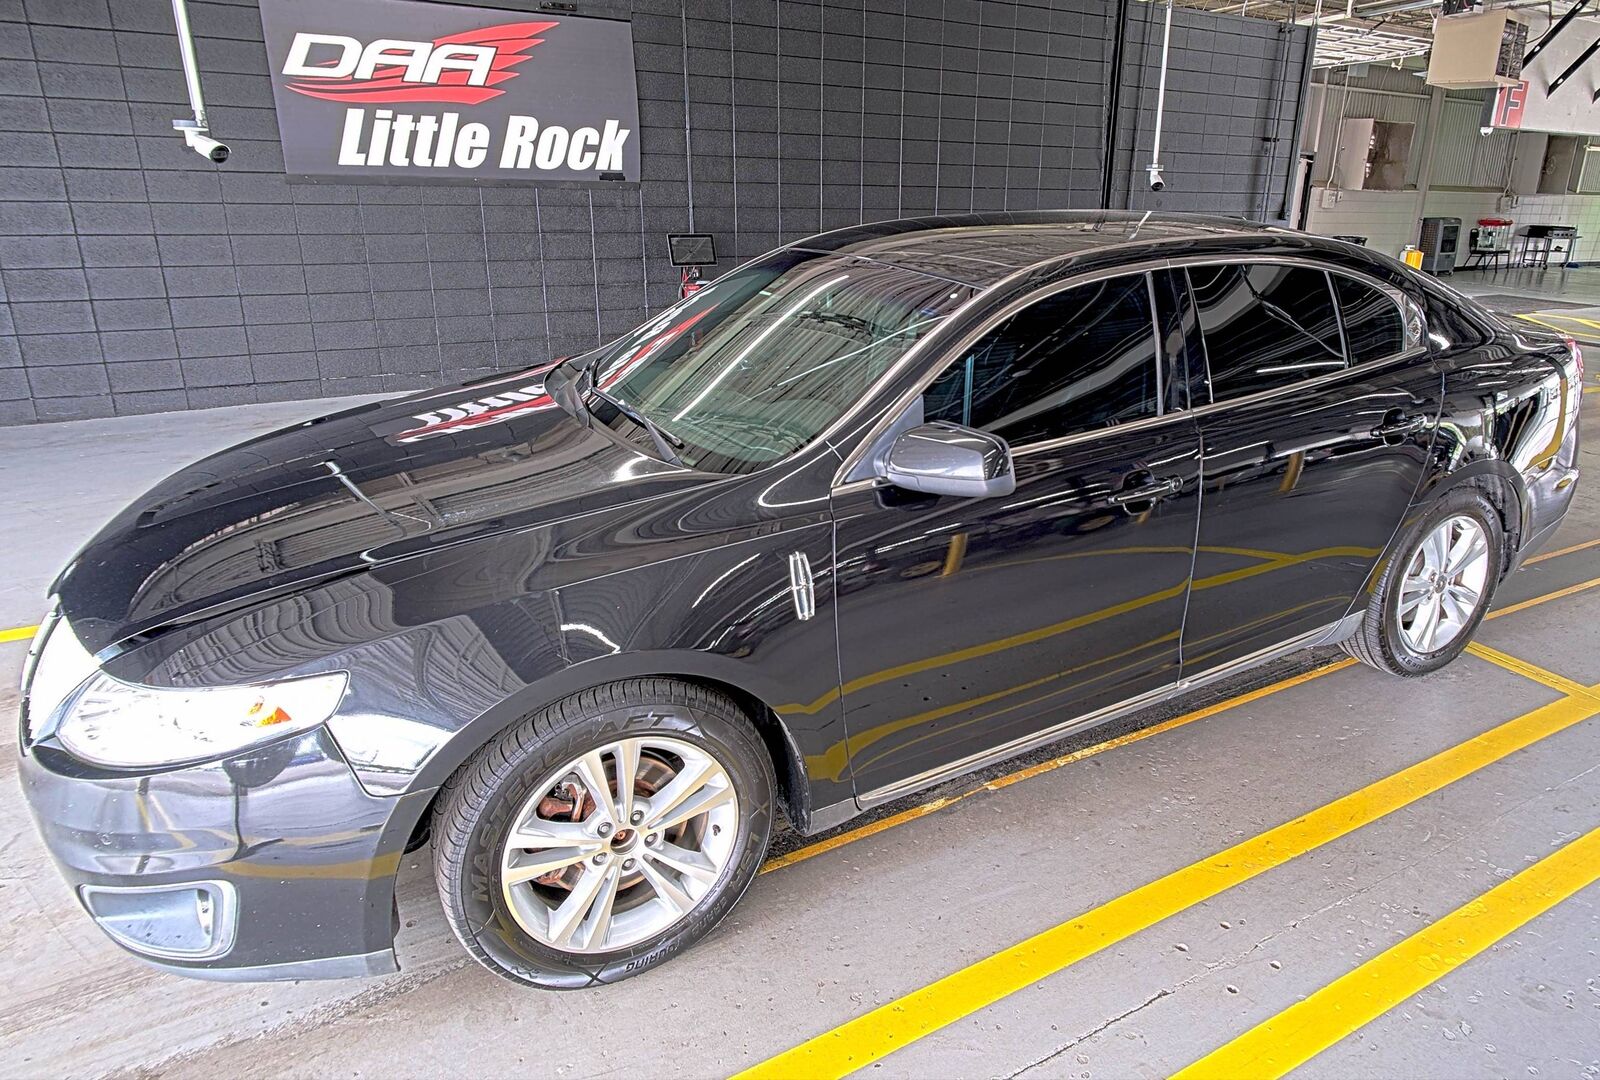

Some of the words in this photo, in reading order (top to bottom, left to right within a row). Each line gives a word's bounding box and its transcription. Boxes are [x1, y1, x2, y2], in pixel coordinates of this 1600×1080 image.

[281, 32, 497, 87] DAA
[1500, 81, 1525, 126] F
[337, 107, 490, 169] Little
[499, 115, 631, 171] Rock
